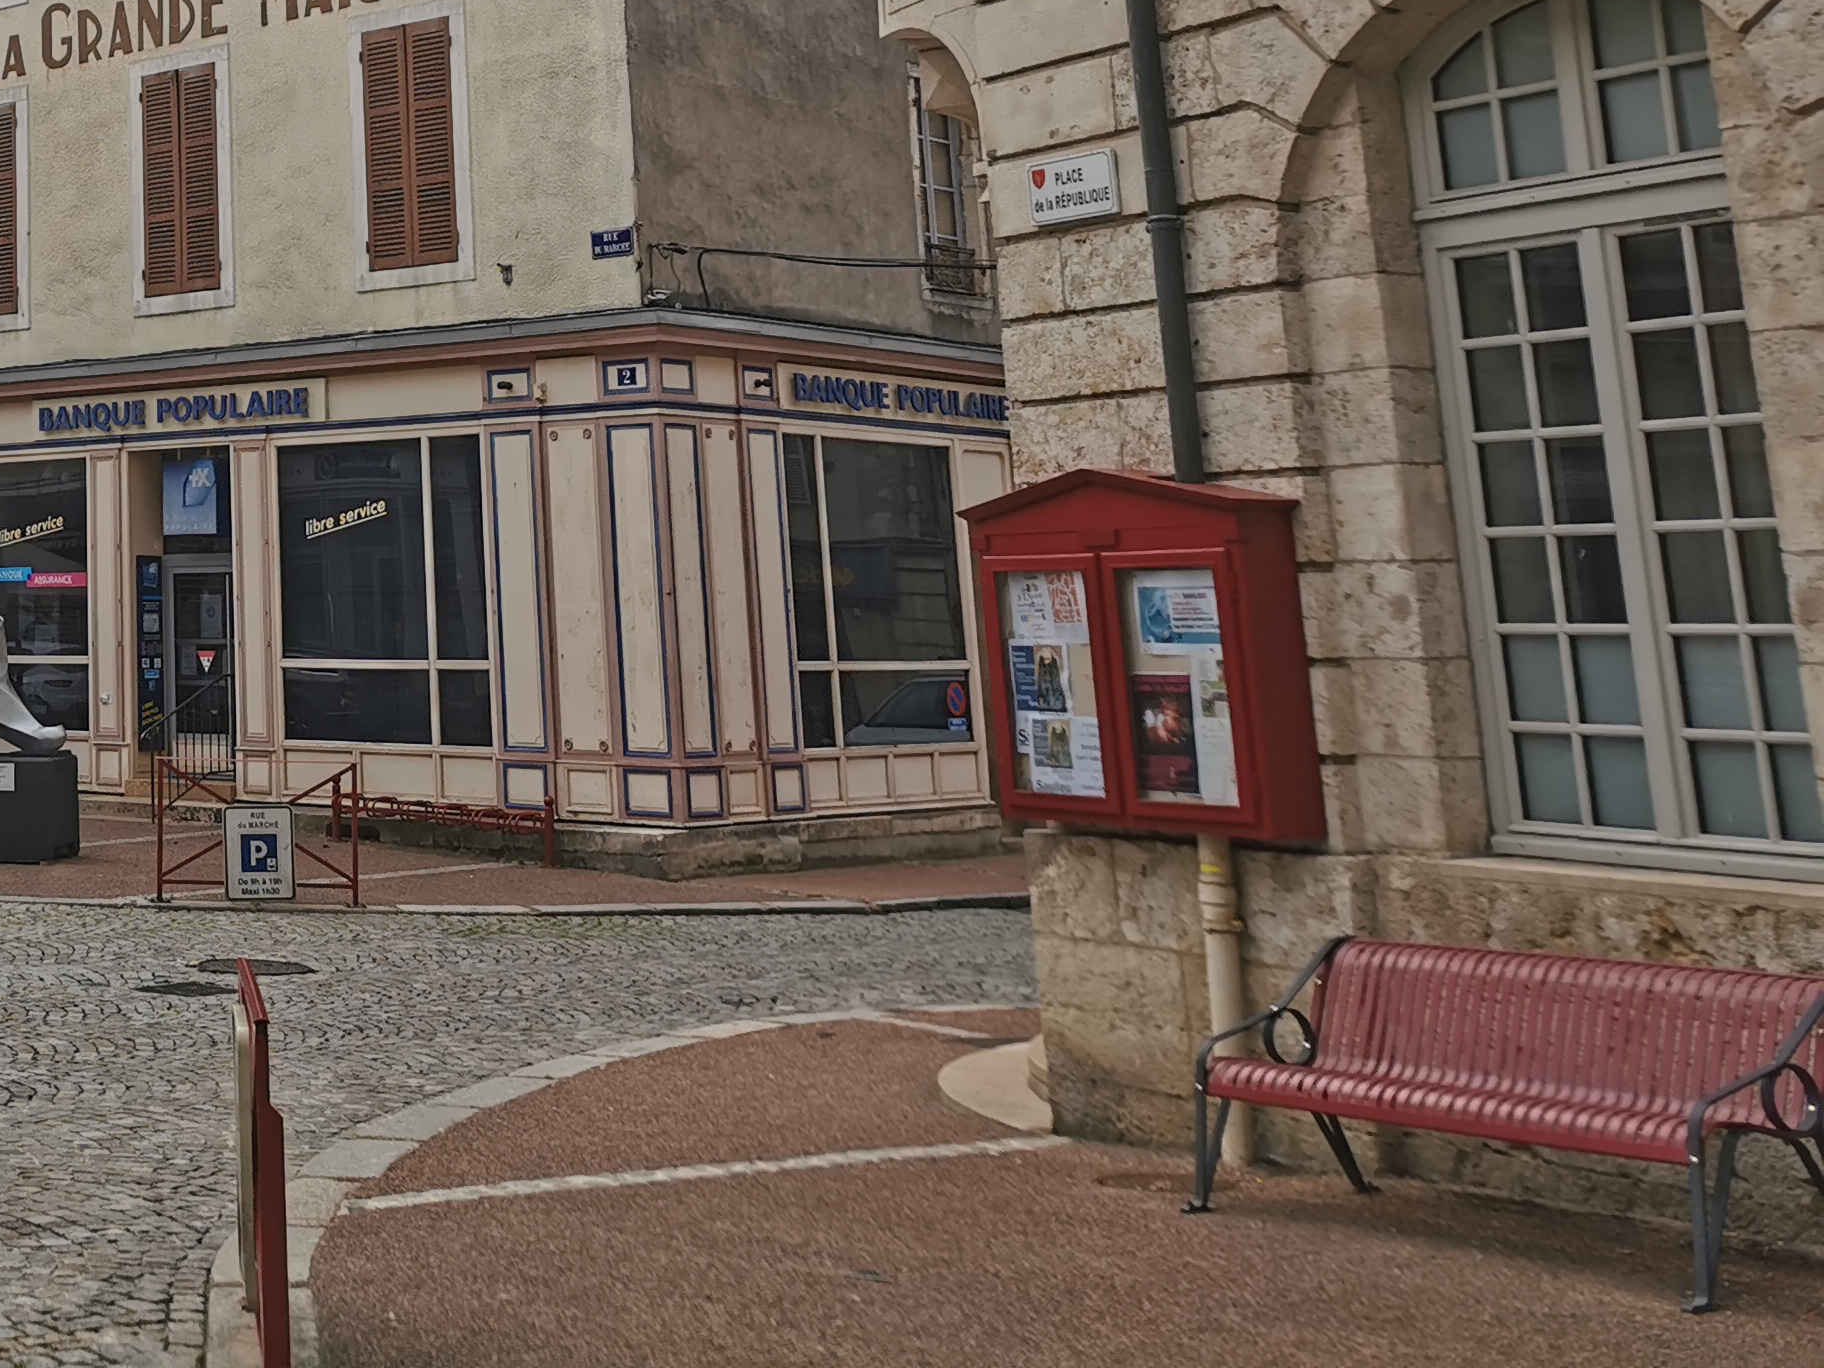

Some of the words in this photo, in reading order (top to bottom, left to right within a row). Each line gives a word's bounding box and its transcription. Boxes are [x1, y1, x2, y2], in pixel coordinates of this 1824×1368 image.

[1054, 168, 1084, 186] PLACE
[1035, 199, 1044, 212] de
[1045, 197, 1054, 211] la
[1055, 186, 1110, 209] RÉPUBLIQUE
[603, 232, 618, 242] RUE
[622, 369, 631, 385] 2
[793, 372, 890, 411] BANQUE
[897, 383, 1010, 421] POPULAIRE
[38, 399, 146, 432] BANQUE
[157, 387, 308, 423] POPULAIRE
[25, 516, 64, 535] service
[306, 515, 334, 535] libre
[339, 498, 386, 524] service
[34, 575, 73, 585] ASSURANCE
[250, 840, 268, 866] P
